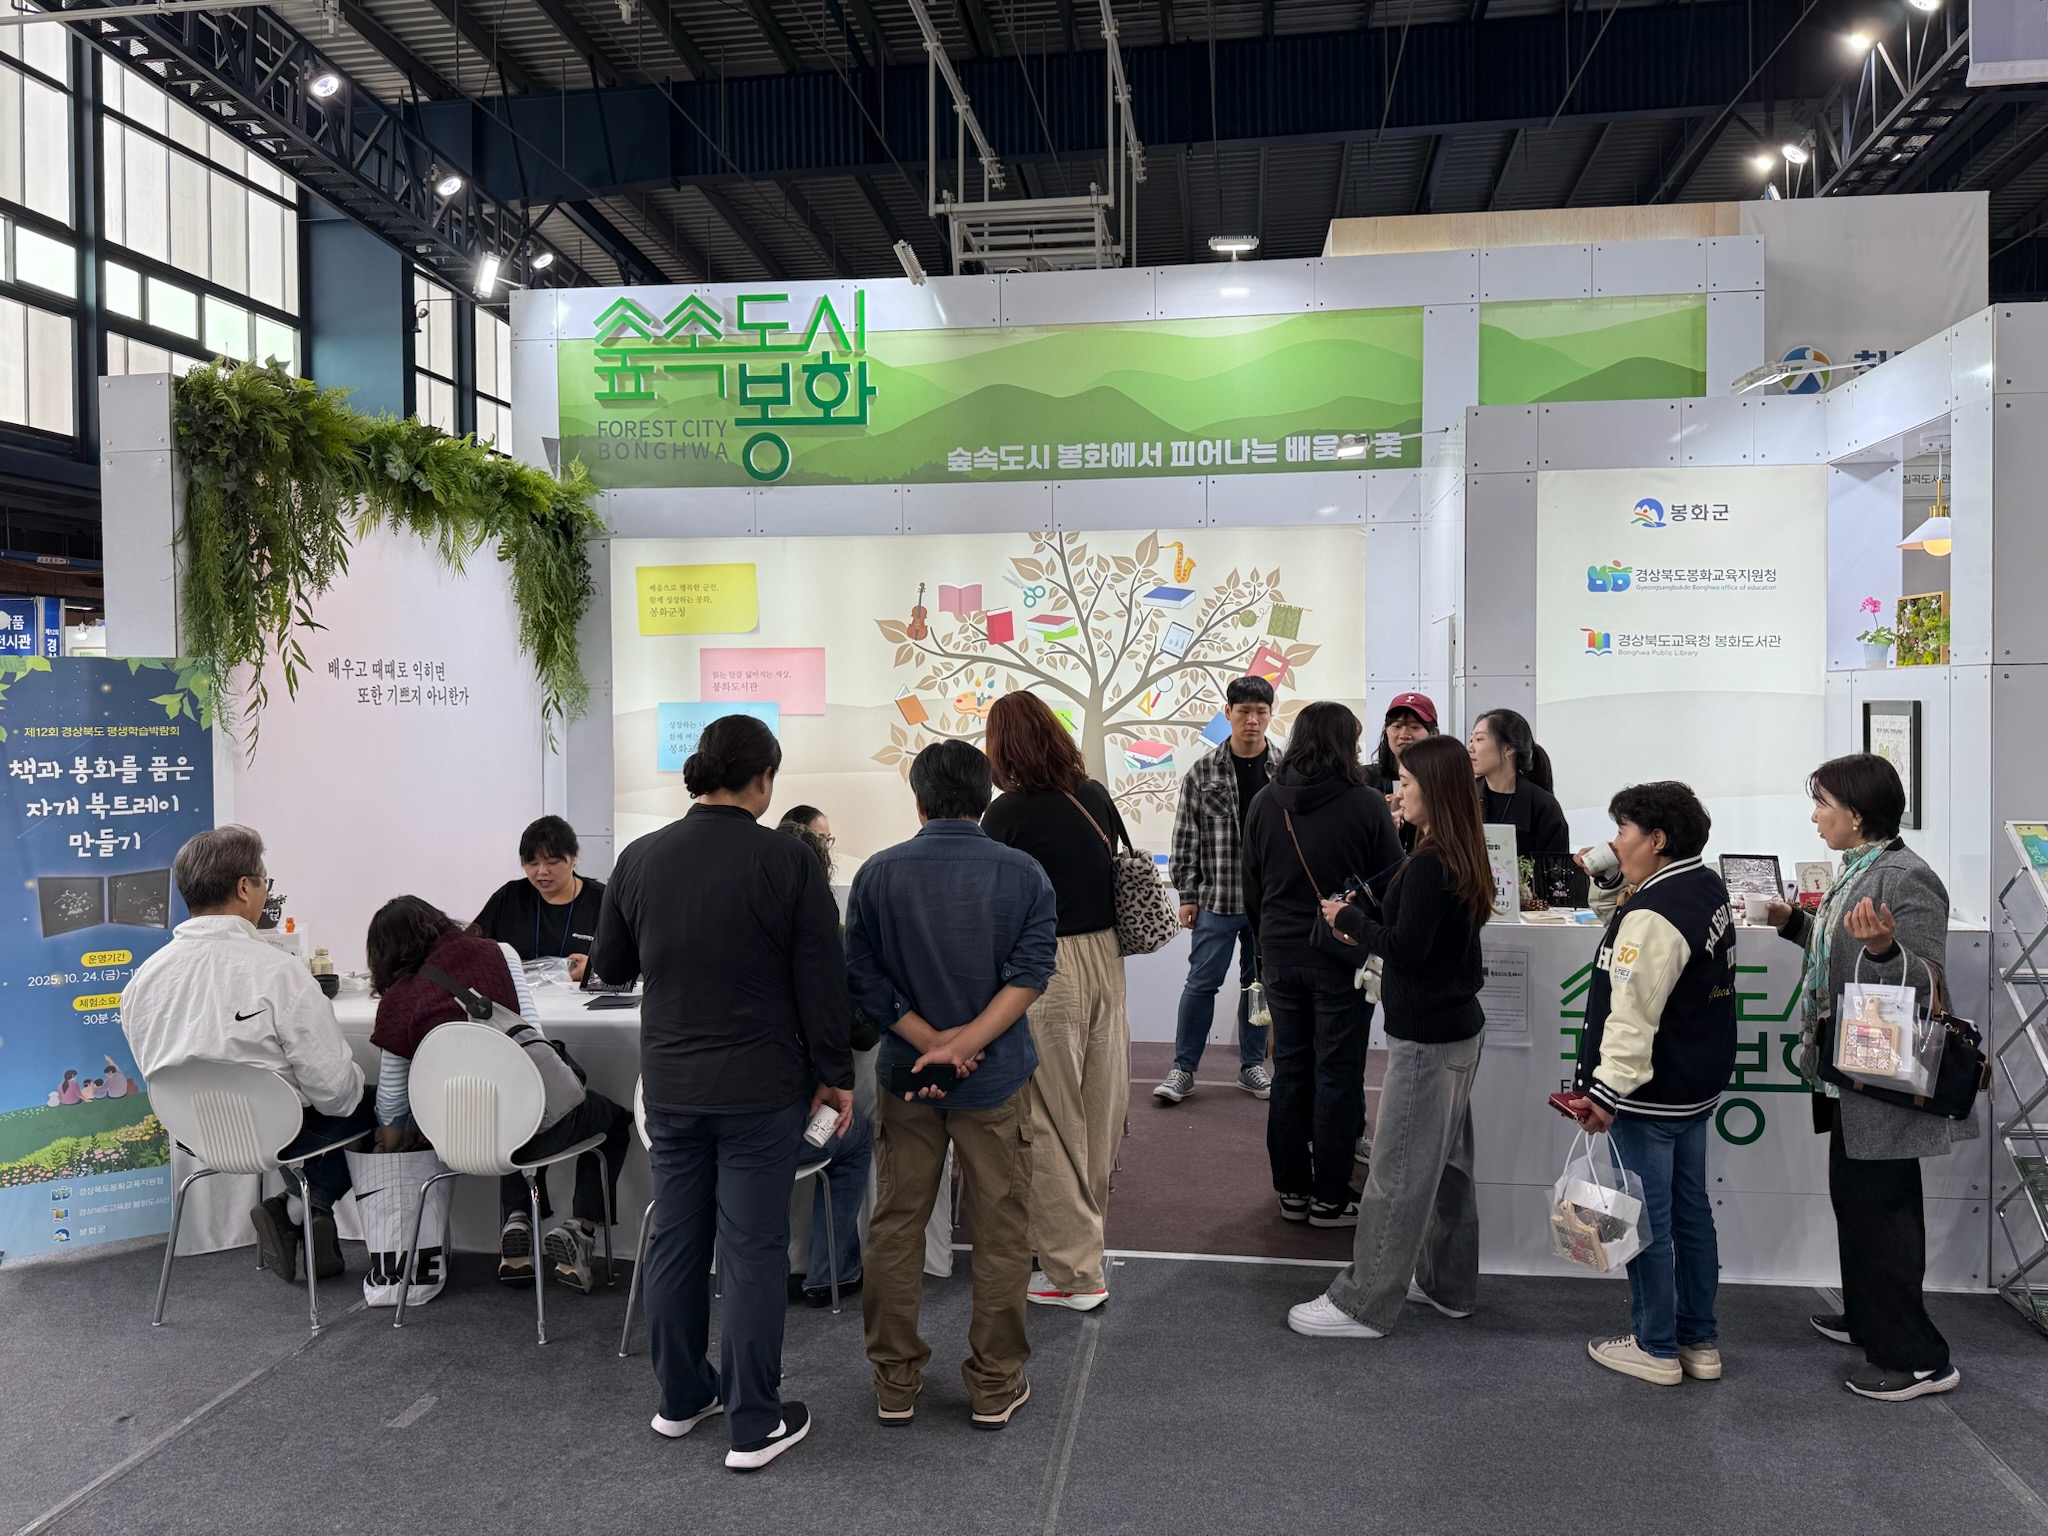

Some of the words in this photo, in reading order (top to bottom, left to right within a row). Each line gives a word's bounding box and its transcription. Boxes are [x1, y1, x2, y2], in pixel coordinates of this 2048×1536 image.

[593, 289, 867, 401] 숲속도시
[734, 351, 878, 482] 봉화
[598, 419, 677, 438] FOREST
[682, 419, 727, 438] CITY
[598, 441, 728, 460] BONGHWA
[947, 444, 1050, 472] 숲속도시
[1057, 442, 1162, 470] 봉화에서
[1170, 438, 1278, 467] 피어나는
[1375, 432, 1402, 459] 꽃
[1670, 503, 1730, 522] 봉화군
[1636, 568, 1777, 583] 경상북도봉화교육지원청
[650, 606, 686, 617] 봉화군청
[1618, 634, 1710, 648] 경상북도교육청
[1714, 634, 1782, 648] 봉화도서관
[1618, 649, 1650, 657] Bonghwa
[1674, 649, 1698, 657] Library
[328, 657, 368, 680] 배우고
[372, 658, 409, 681] 때때로
[412, 660, 446, 682] 익히면
[357, 684, 383, 706] 또한
[387, 684, 421, 707] 기쁘지
[426, 685, 470, 707] 아니한가
[712, 681, 758, 692] 봉화도서관
[24, 726, 59, 738] 제12회
[61, 726, 105, 738] 경상북도
[107, 725, 180, 737] 평생학습박람회
[9, 757, 63, 785] 책과
[69, 755, 142, 785] 봉화를
[148, 756, 195, 782] 품은
[26, 796, 80, 818] 자개
[85, 792, 180, 820] 북트레이
[69, 828, 141, 858] 만들기
[88, 952, 126, 965] 운영기간
[1617, 946, 1639, 965] 30
[27, 974, 61, 987] 2025.
[64, 973, 79, 984] 10.
[83, 1013, 109, 1025] 30분
[79, 1224, 106, 1237] 봉화군
